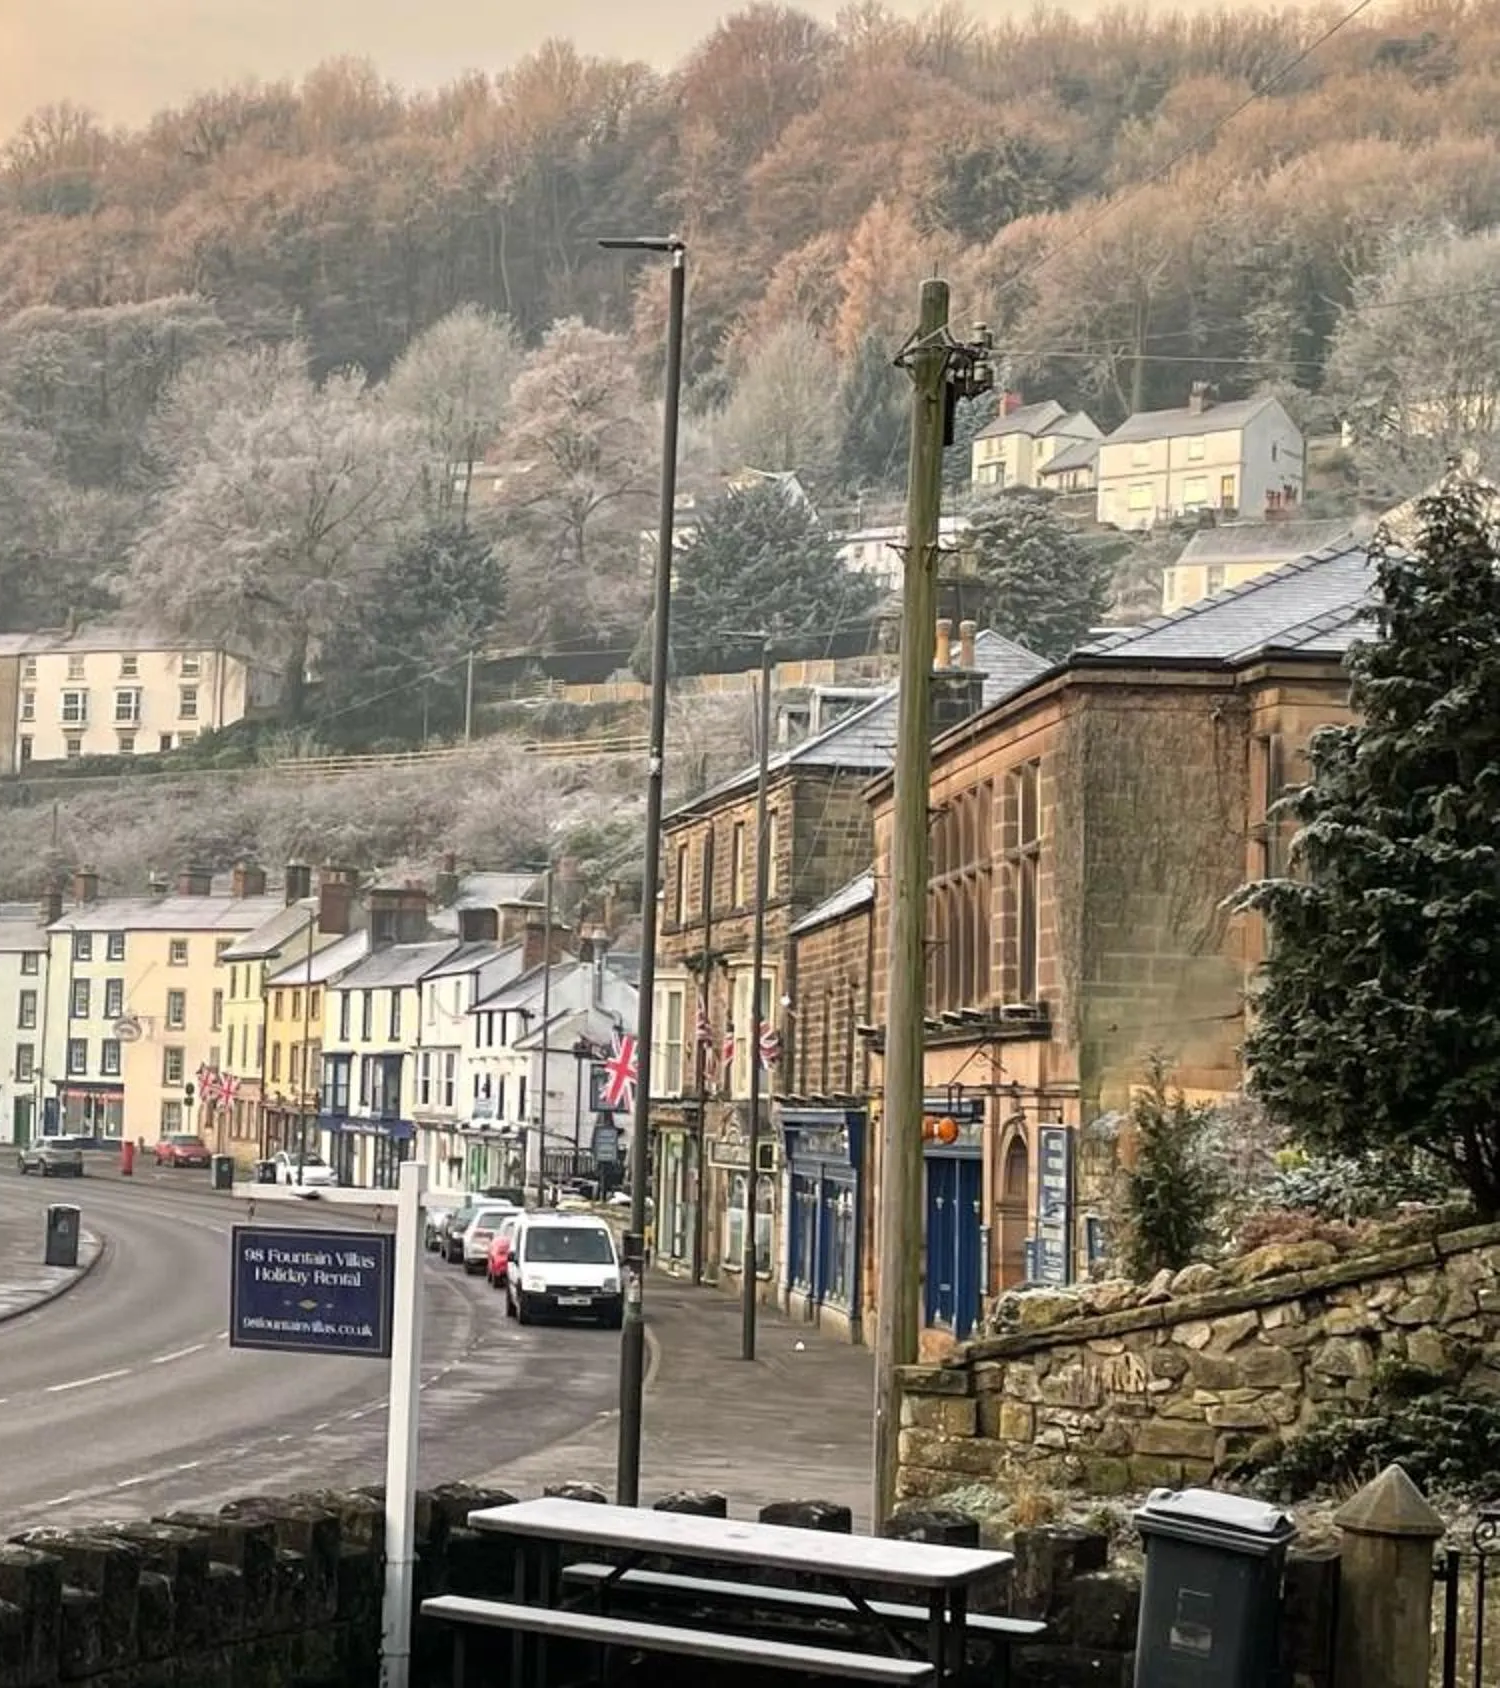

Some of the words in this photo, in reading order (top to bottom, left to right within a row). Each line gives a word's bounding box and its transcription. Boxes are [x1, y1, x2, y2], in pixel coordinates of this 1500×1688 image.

[244, 1247, 265, 1262] 98
[267, 1248, 333, 1267] Fountain
[334, 1250, 375, 1269] Villas
[255, 1266, 308, 1287] Holiday
[313, 1269, 361, 1287] Rental
